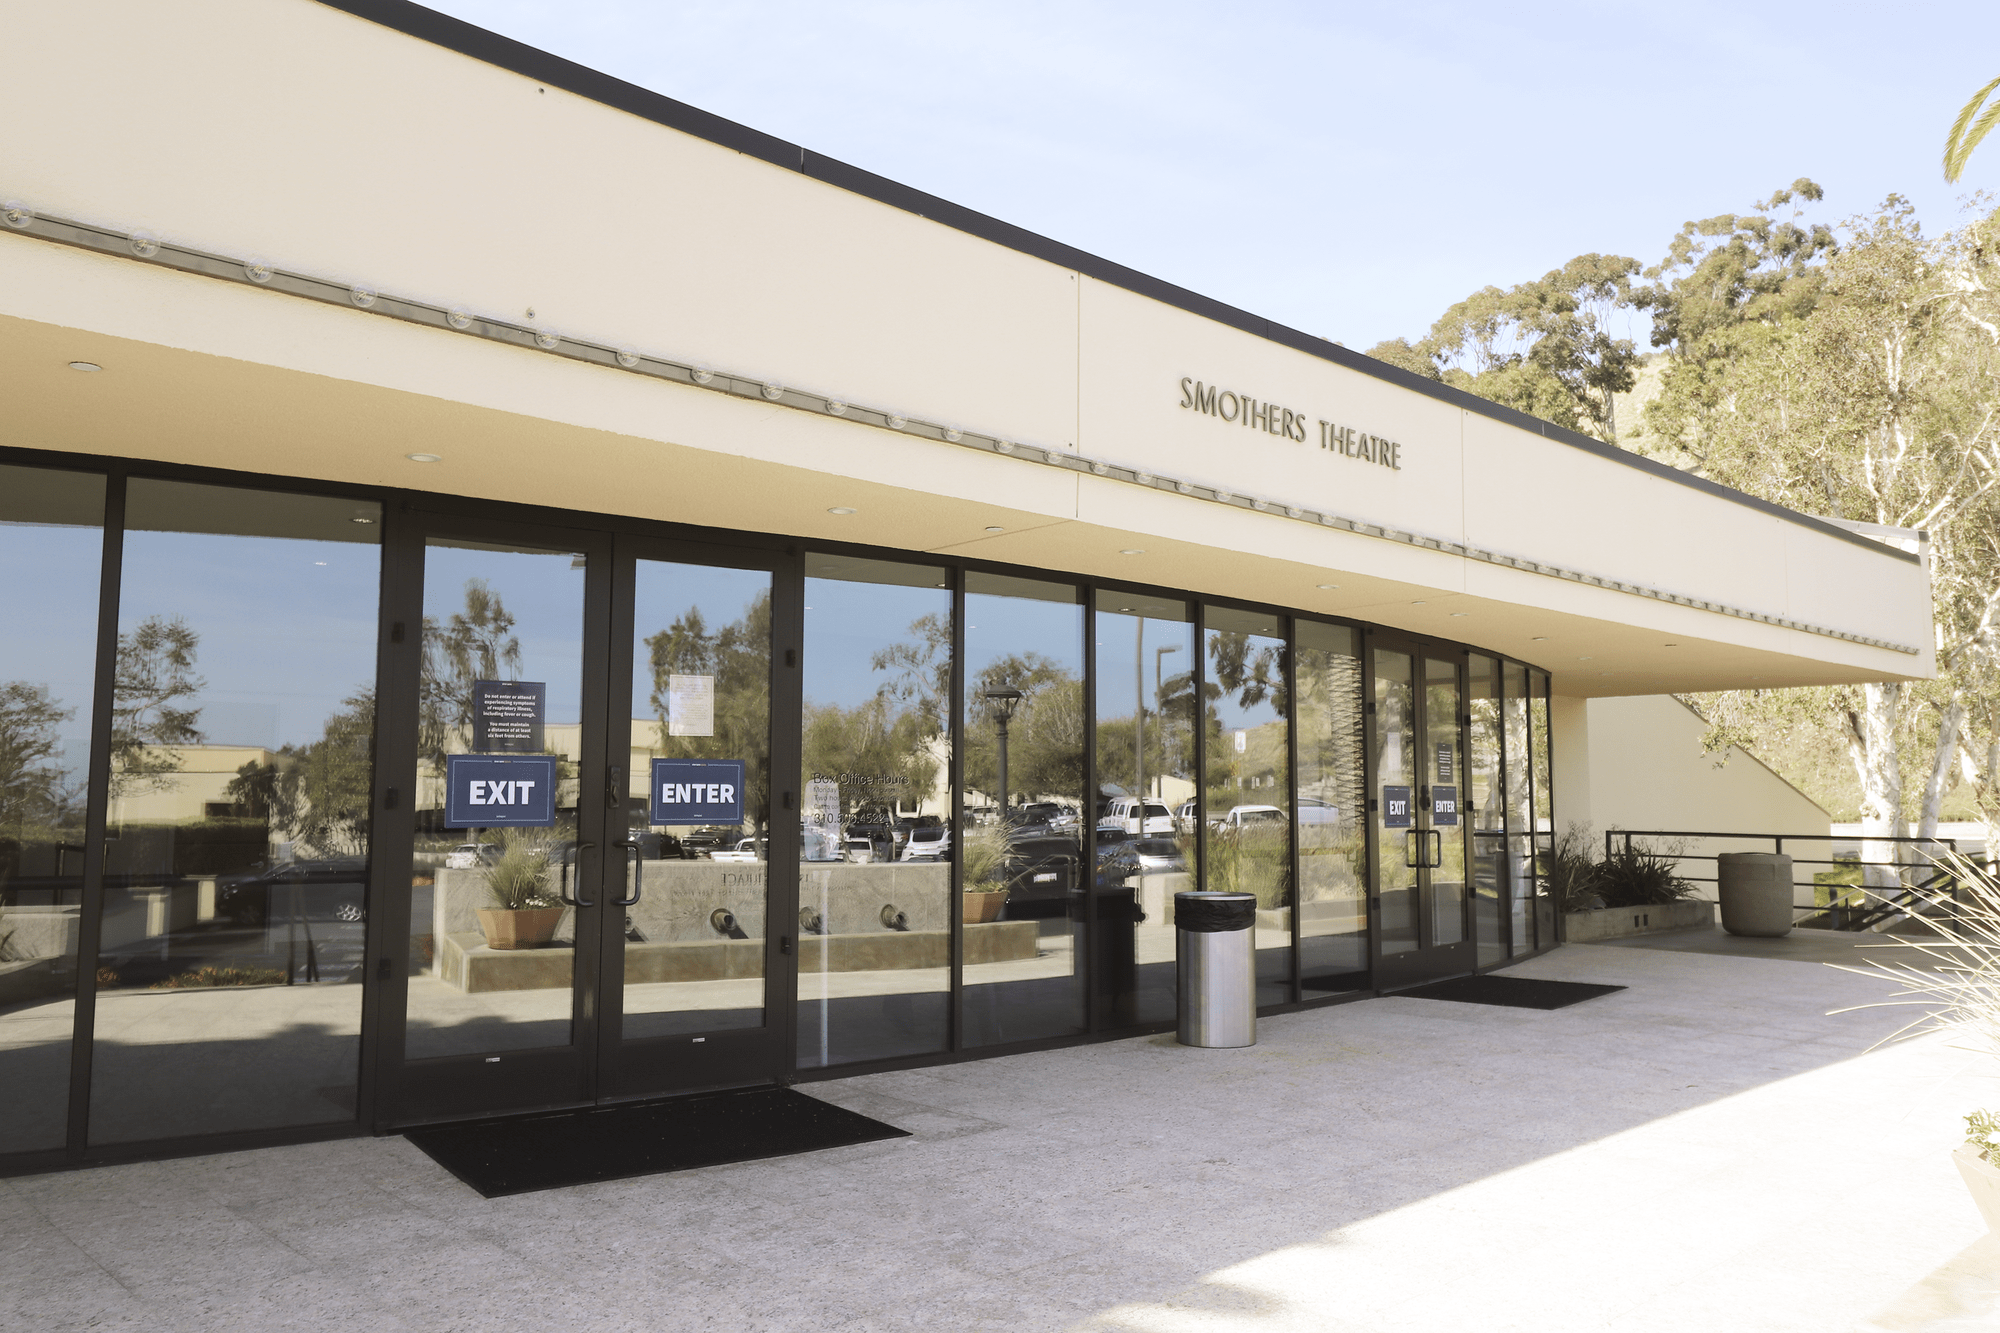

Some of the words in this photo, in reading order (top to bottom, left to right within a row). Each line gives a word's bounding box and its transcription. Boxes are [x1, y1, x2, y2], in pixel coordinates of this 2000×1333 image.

[1180, 376, 1307, 443] SMOTHERS
[1319, 419, 1402, 471] THEATRE
[814, 773, 836, 784] Box
[840, 773, 874, 785] Office
[876, 774, 910, 785] Hours
[469, 780, 536, 805] EXIT
[662, 783, 735, 804] ENTER
[1389, 800, 1406, 815] EXIT
[1435, 800, 1455, 813] ENTER
